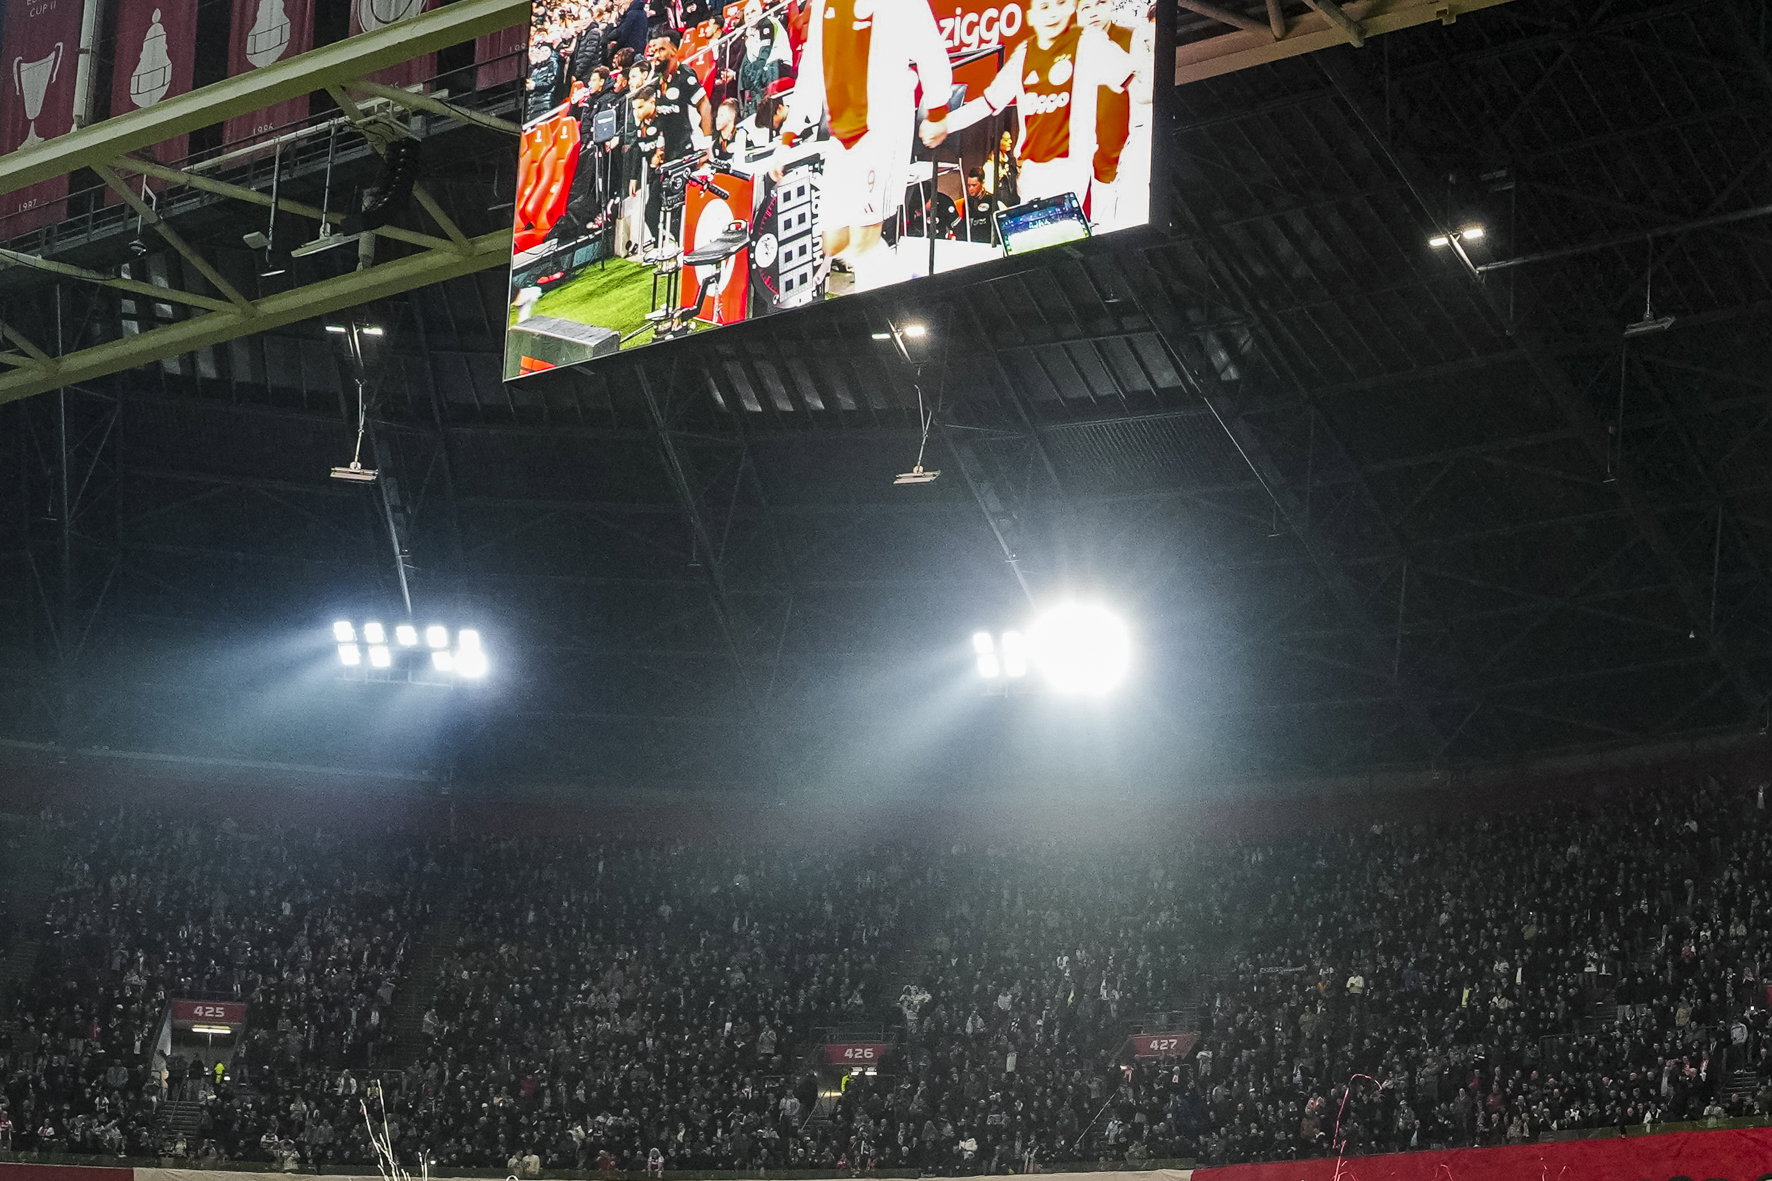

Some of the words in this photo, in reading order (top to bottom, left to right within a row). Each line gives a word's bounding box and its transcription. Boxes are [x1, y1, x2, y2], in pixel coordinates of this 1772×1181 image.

[30, 4, 48, 18] CUP
[939, 3, 1022, 52] ziggo
[193, 1005, 226, 1019] 425
[1149, 1038, 1178, 1053] 427
[843, 1047, 874, 1060] 426
